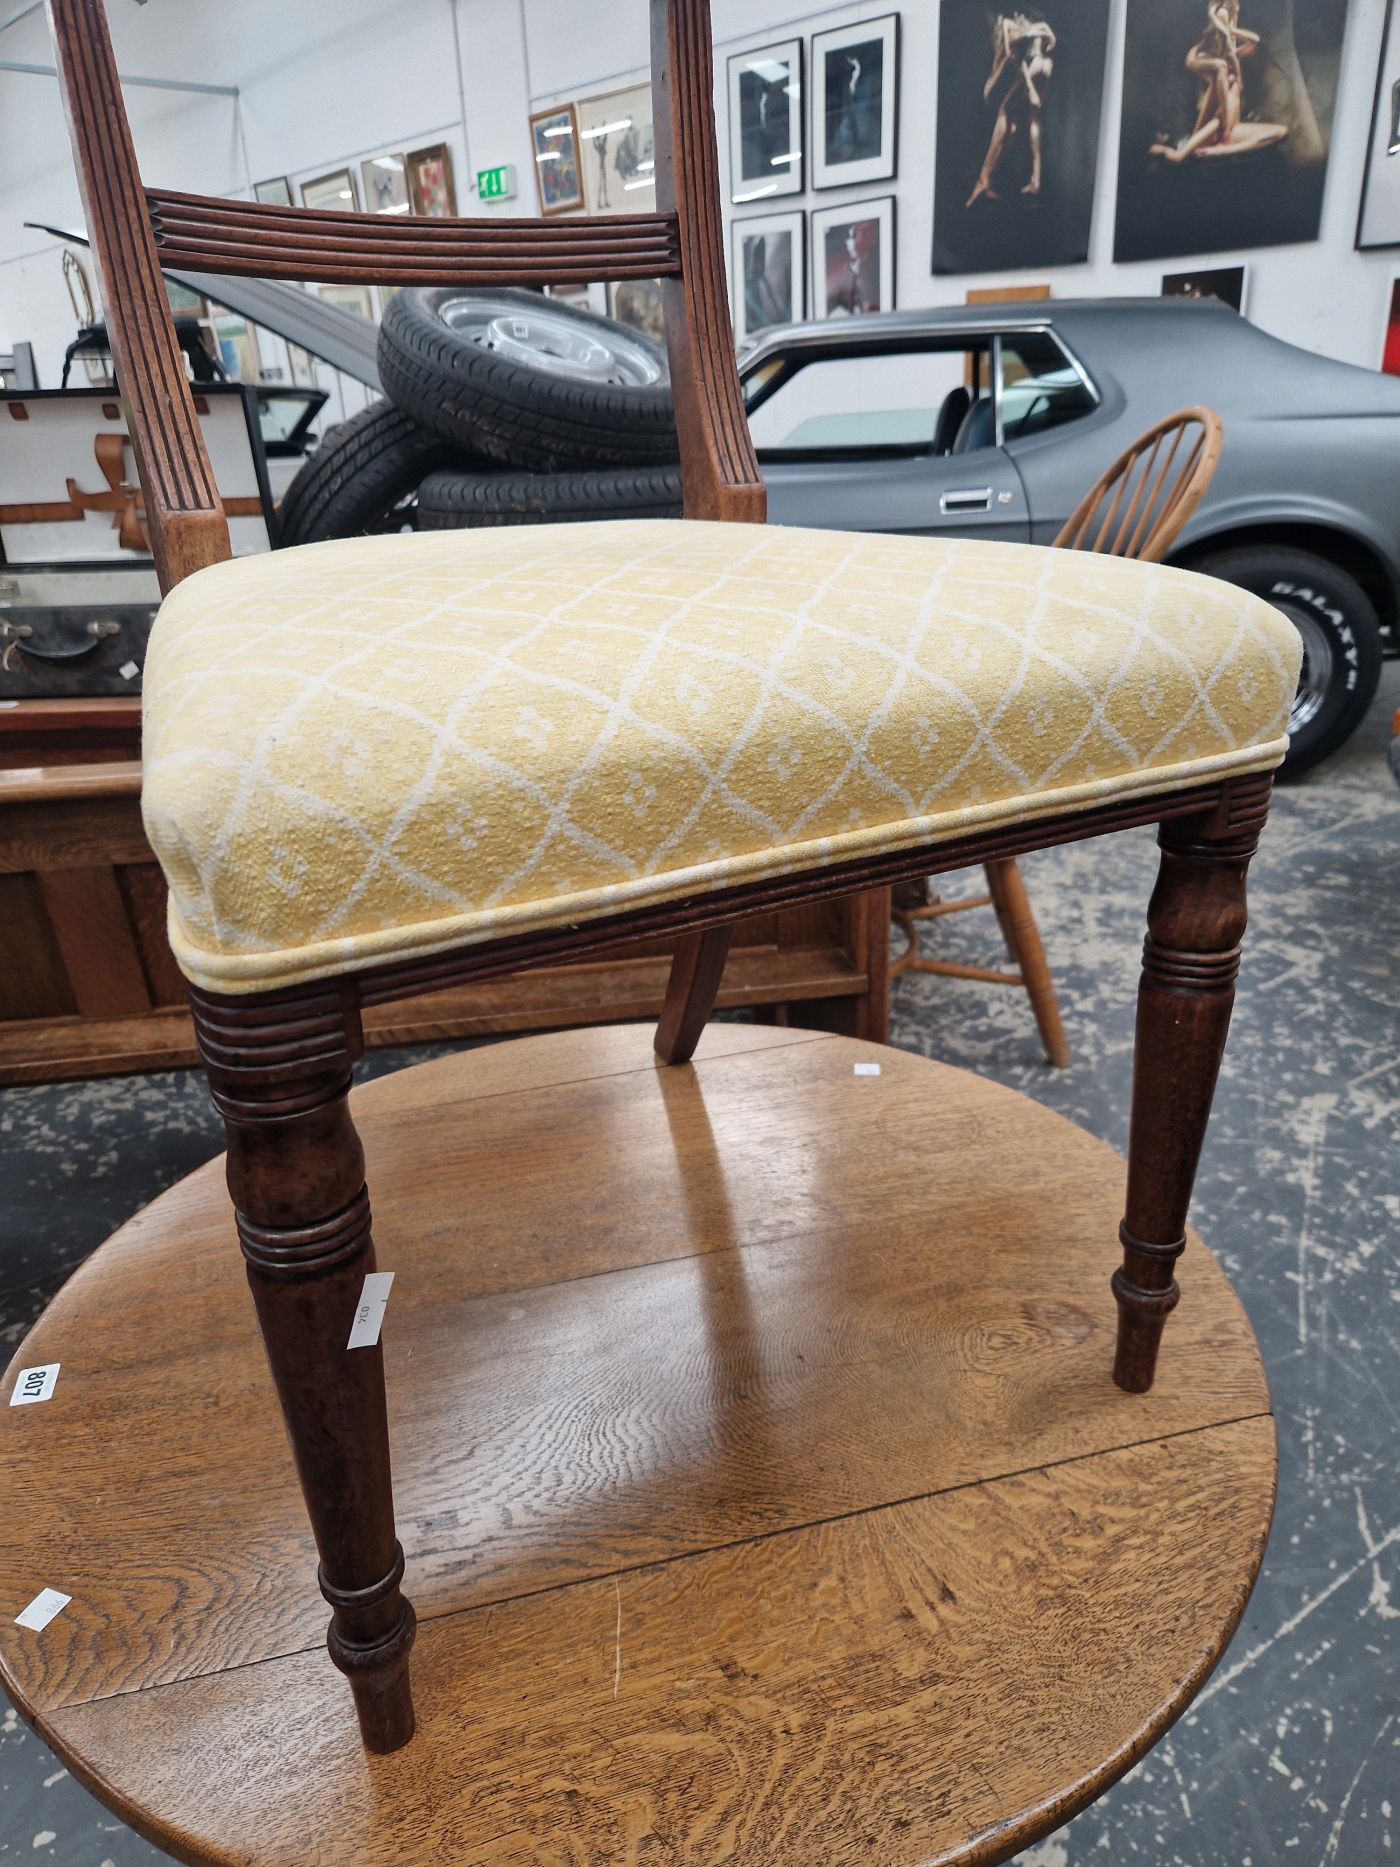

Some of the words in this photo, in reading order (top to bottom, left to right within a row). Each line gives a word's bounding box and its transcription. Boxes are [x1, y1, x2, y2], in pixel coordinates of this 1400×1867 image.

[1271, 581, 1358, 667] GALAXY
[357, 1306, 370, 1324] 034
[22, 1371, 47, 1397] 807
[46, 1599, 65, 1615] 866
